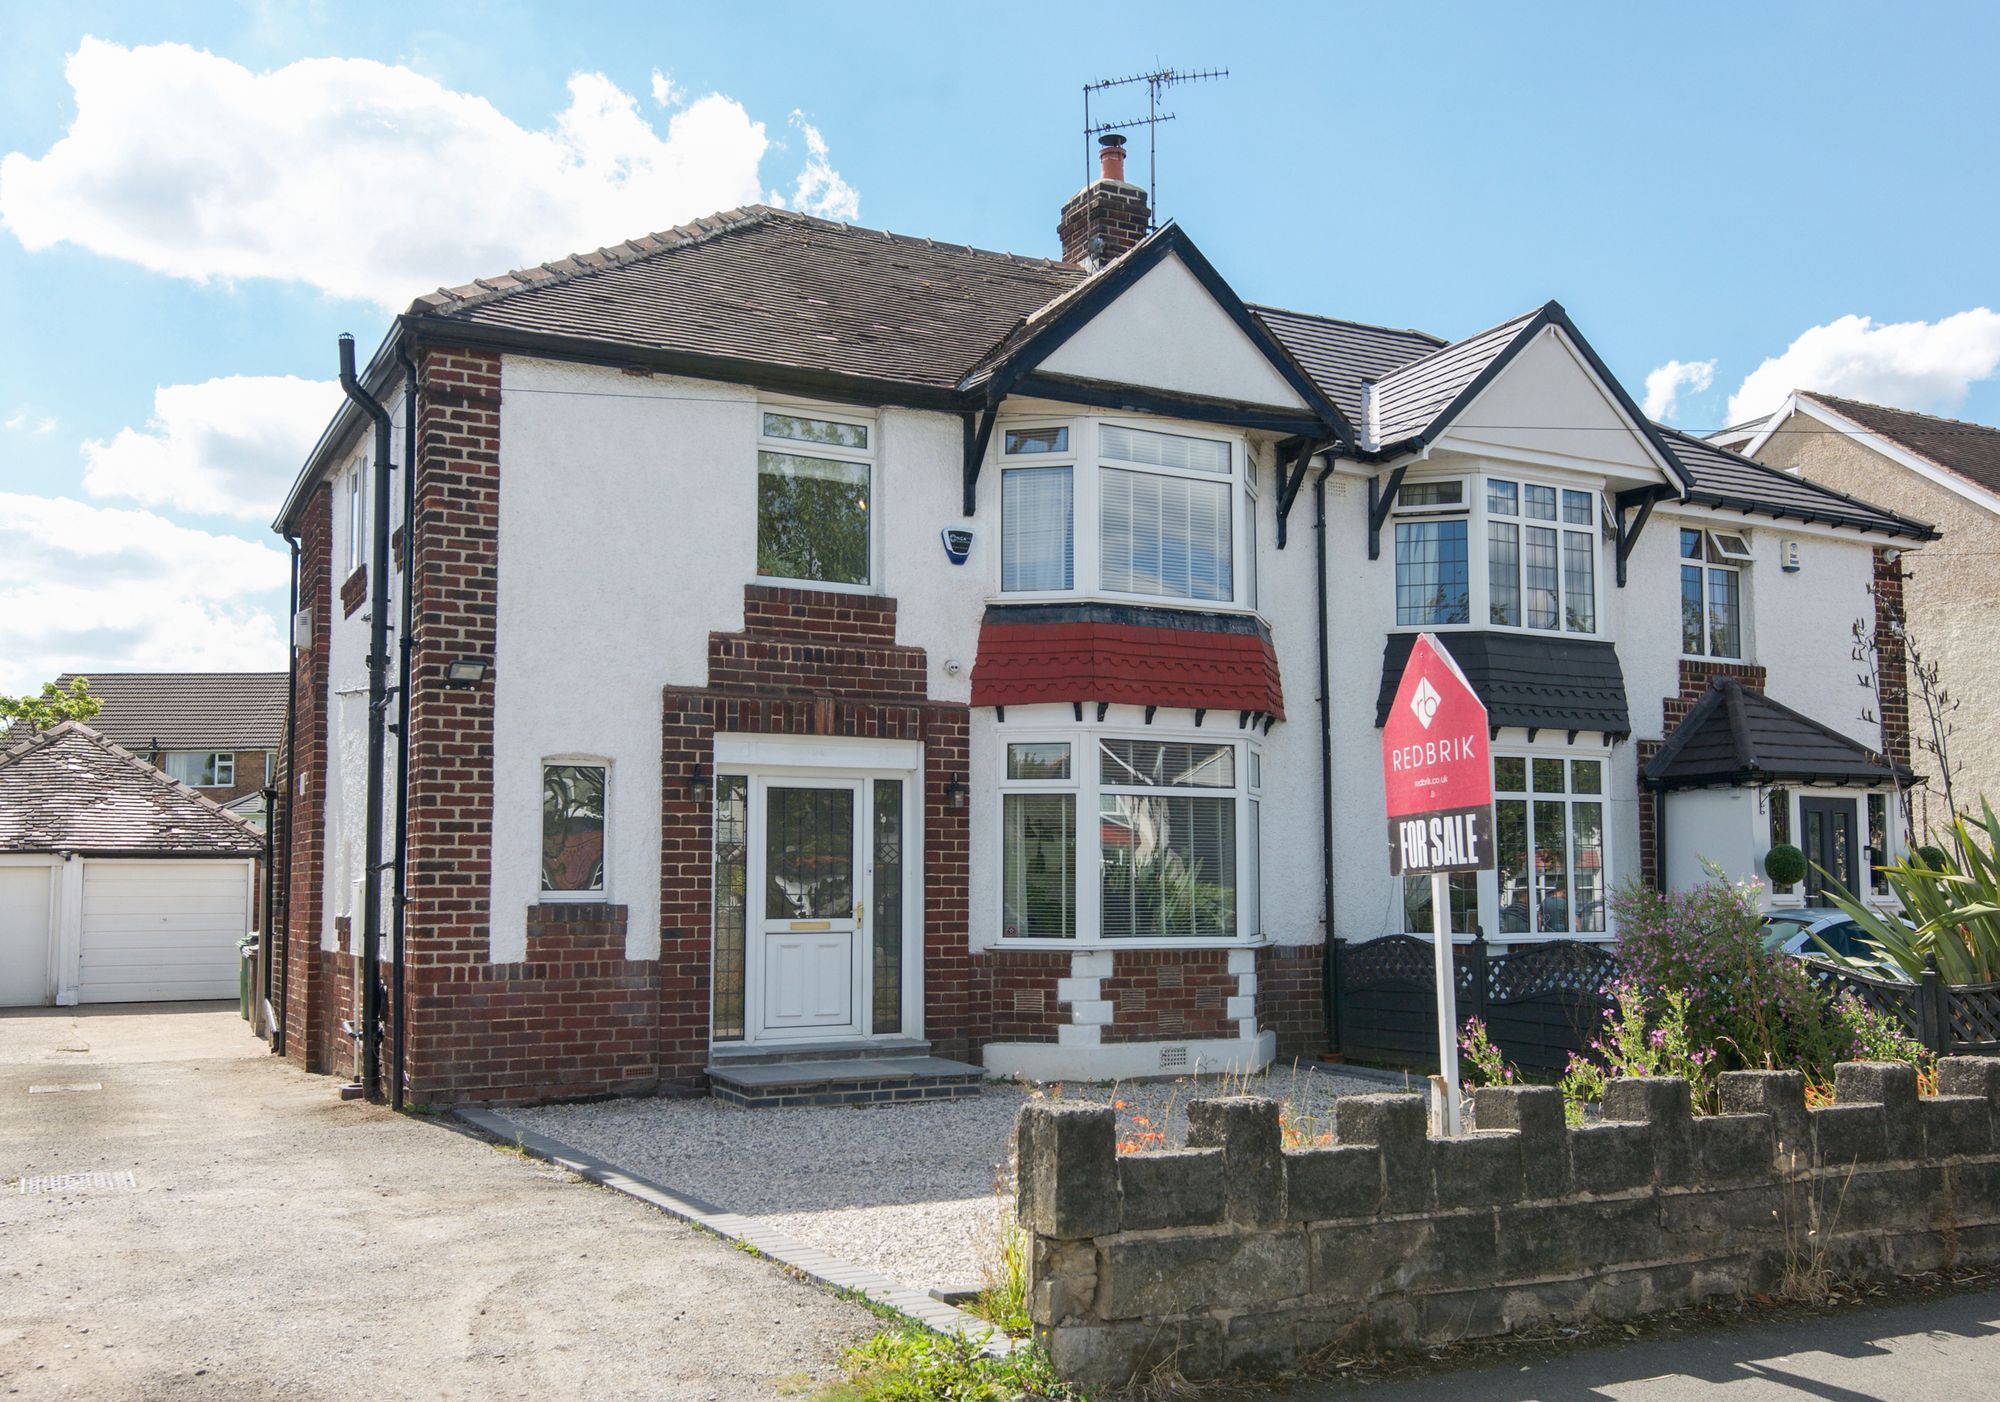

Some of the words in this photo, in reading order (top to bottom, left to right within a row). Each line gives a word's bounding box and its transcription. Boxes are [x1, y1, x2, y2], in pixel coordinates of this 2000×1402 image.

[1392, 735, 1475, 771] REDBRIK
[1399, 819, 1429, 869] FOR
[1430, 814, 1479, 867] SALE
